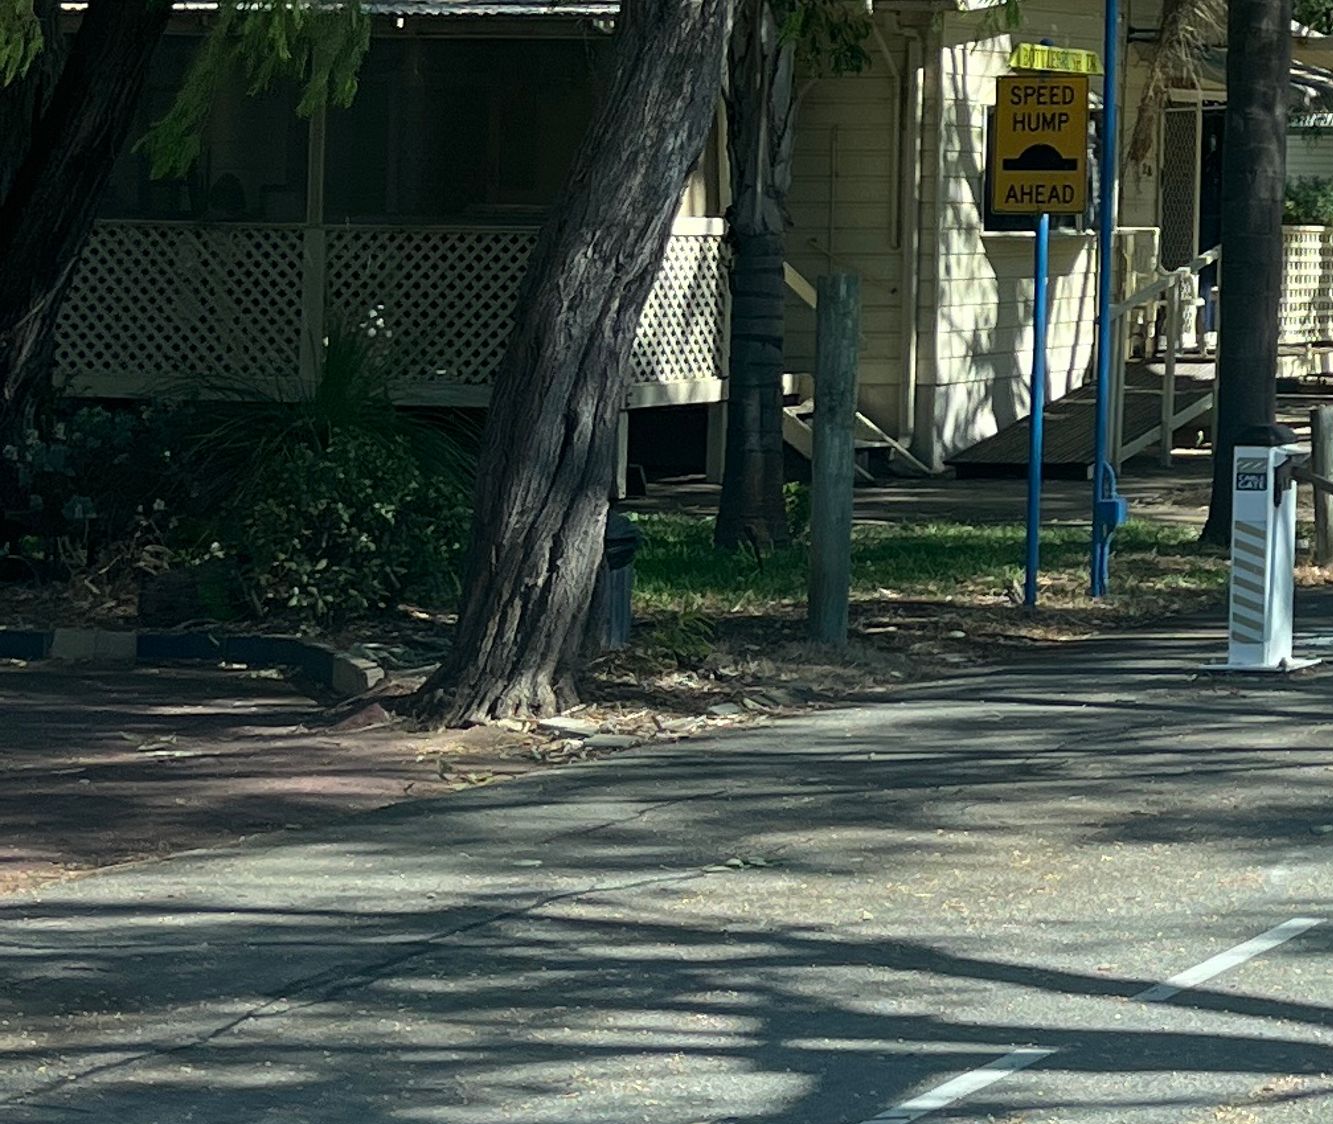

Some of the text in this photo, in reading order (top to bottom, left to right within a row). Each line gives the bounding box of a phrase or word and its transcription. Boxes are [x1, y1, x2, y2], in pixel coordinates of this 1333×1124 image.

[1010, 85, 1075, 106] SPEED
[1012, 112, 1070, 132] HUMP
[1004, 184, 1075, 205] AHEAD
